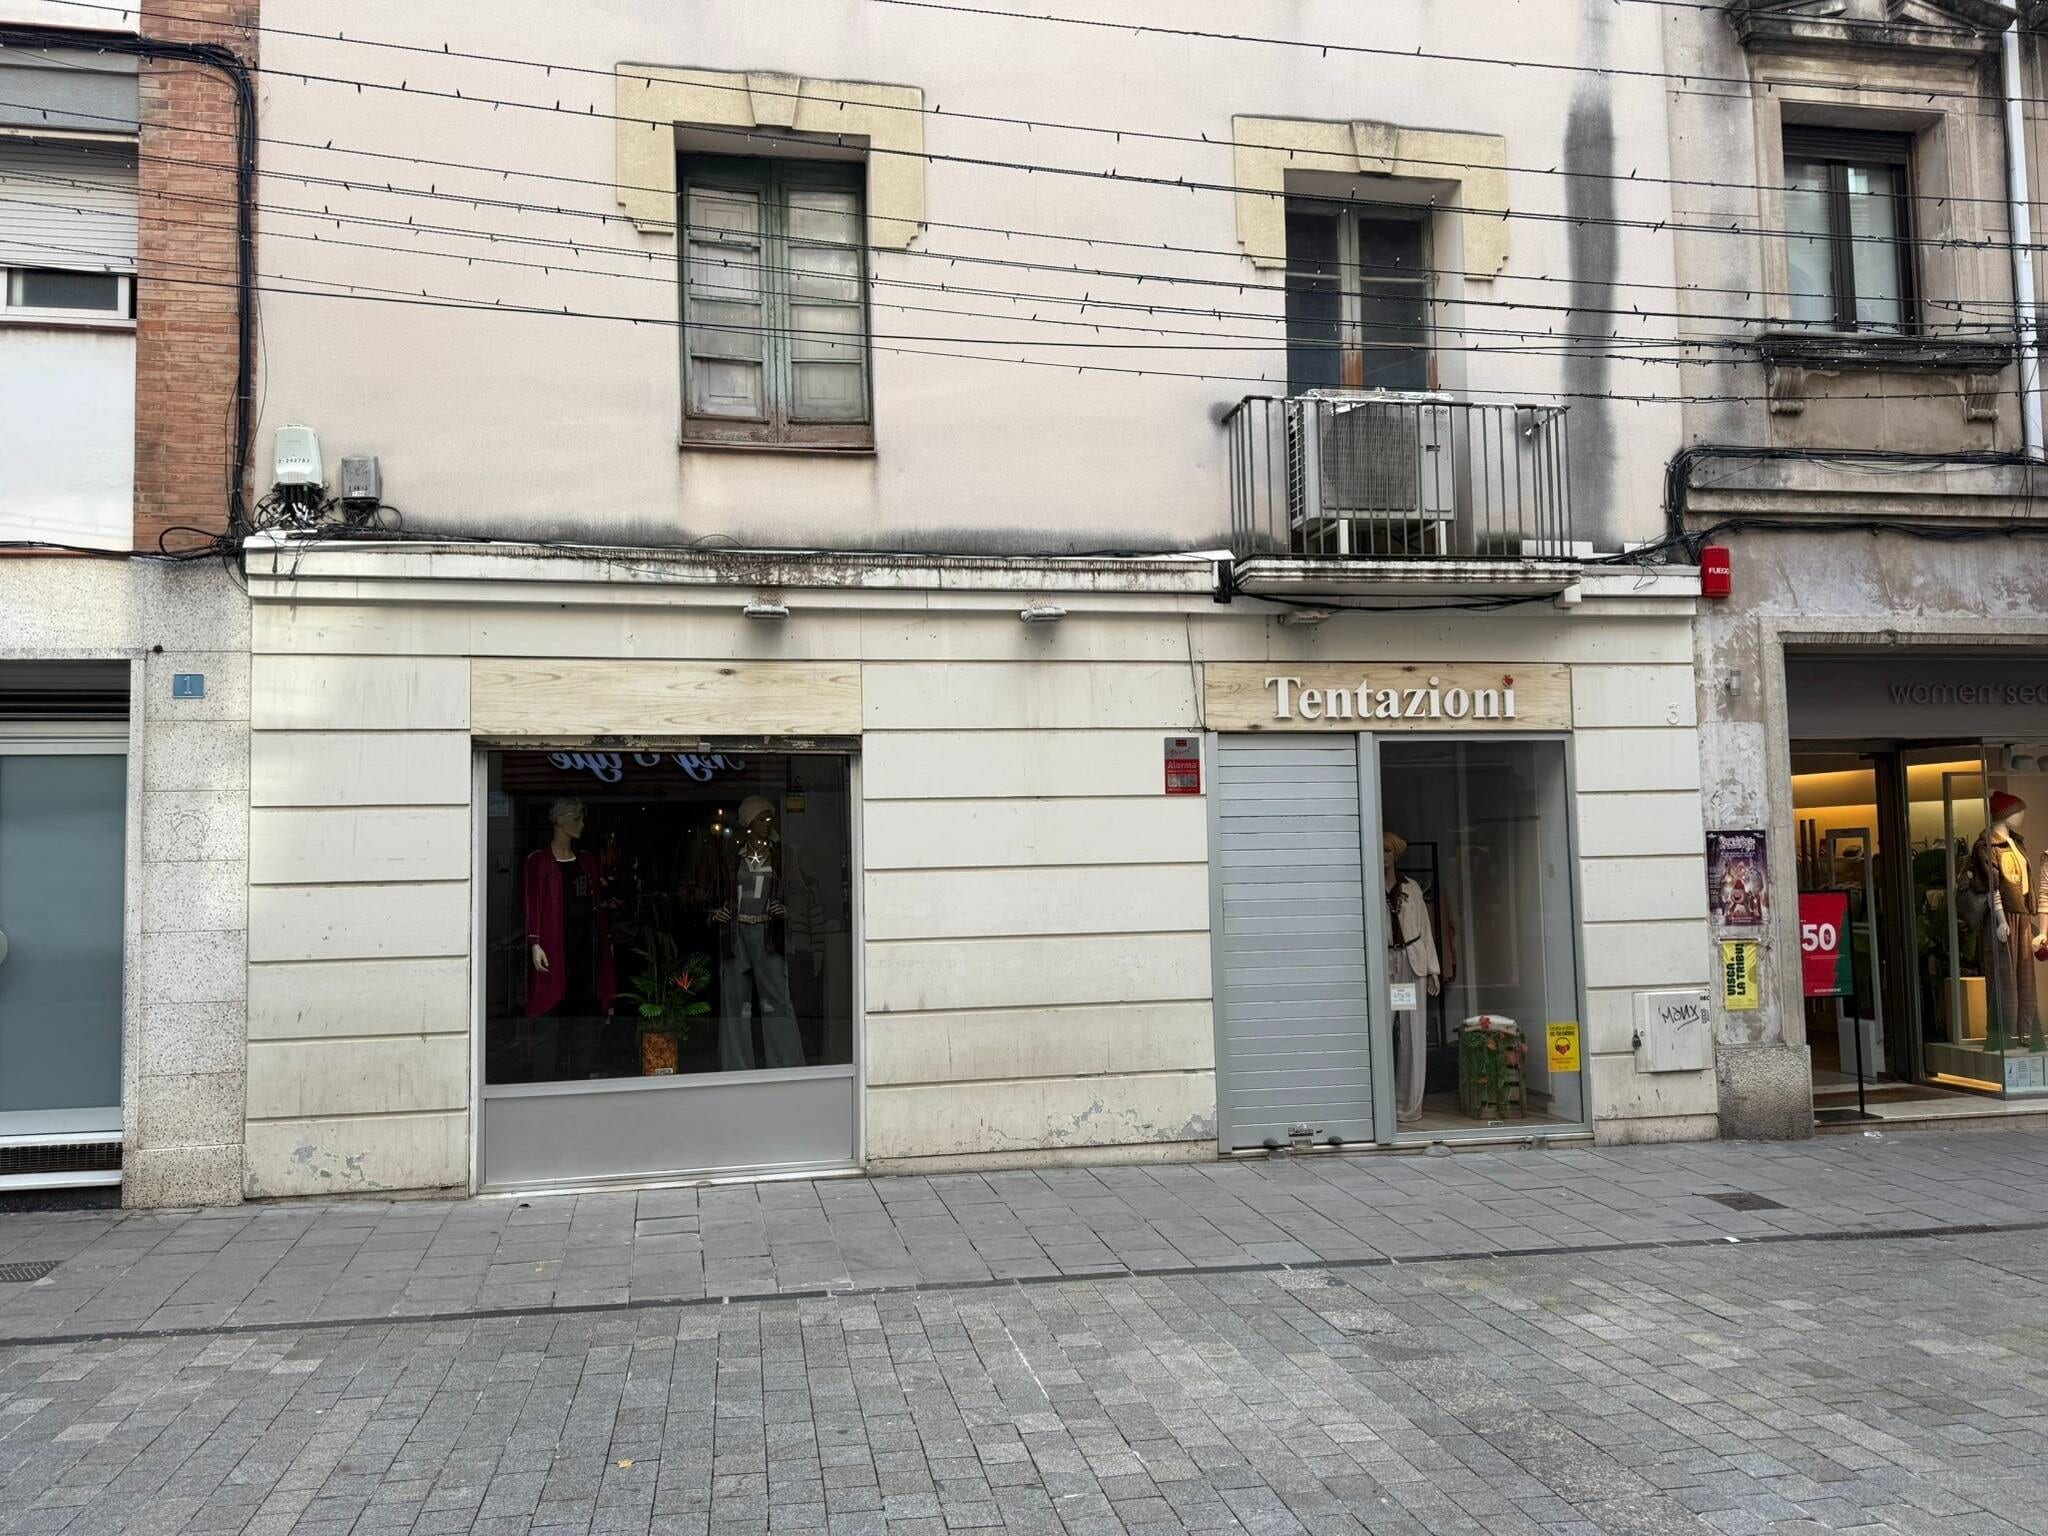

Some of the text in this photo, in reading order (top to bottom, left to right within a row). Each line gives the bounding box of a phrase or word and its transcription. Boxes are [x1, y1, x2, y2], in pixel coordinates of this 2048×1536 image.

[1708, 567, 1730, 575] FUEGO
[183, 675, 192, 695] 1
[1264, 674, 1517, 720] Tentazioni
[1167, 760, 1197, 769] Alarma
[1726, 963, 1736, 996] VISCA
[1736, 982, 1746, 996] LA
